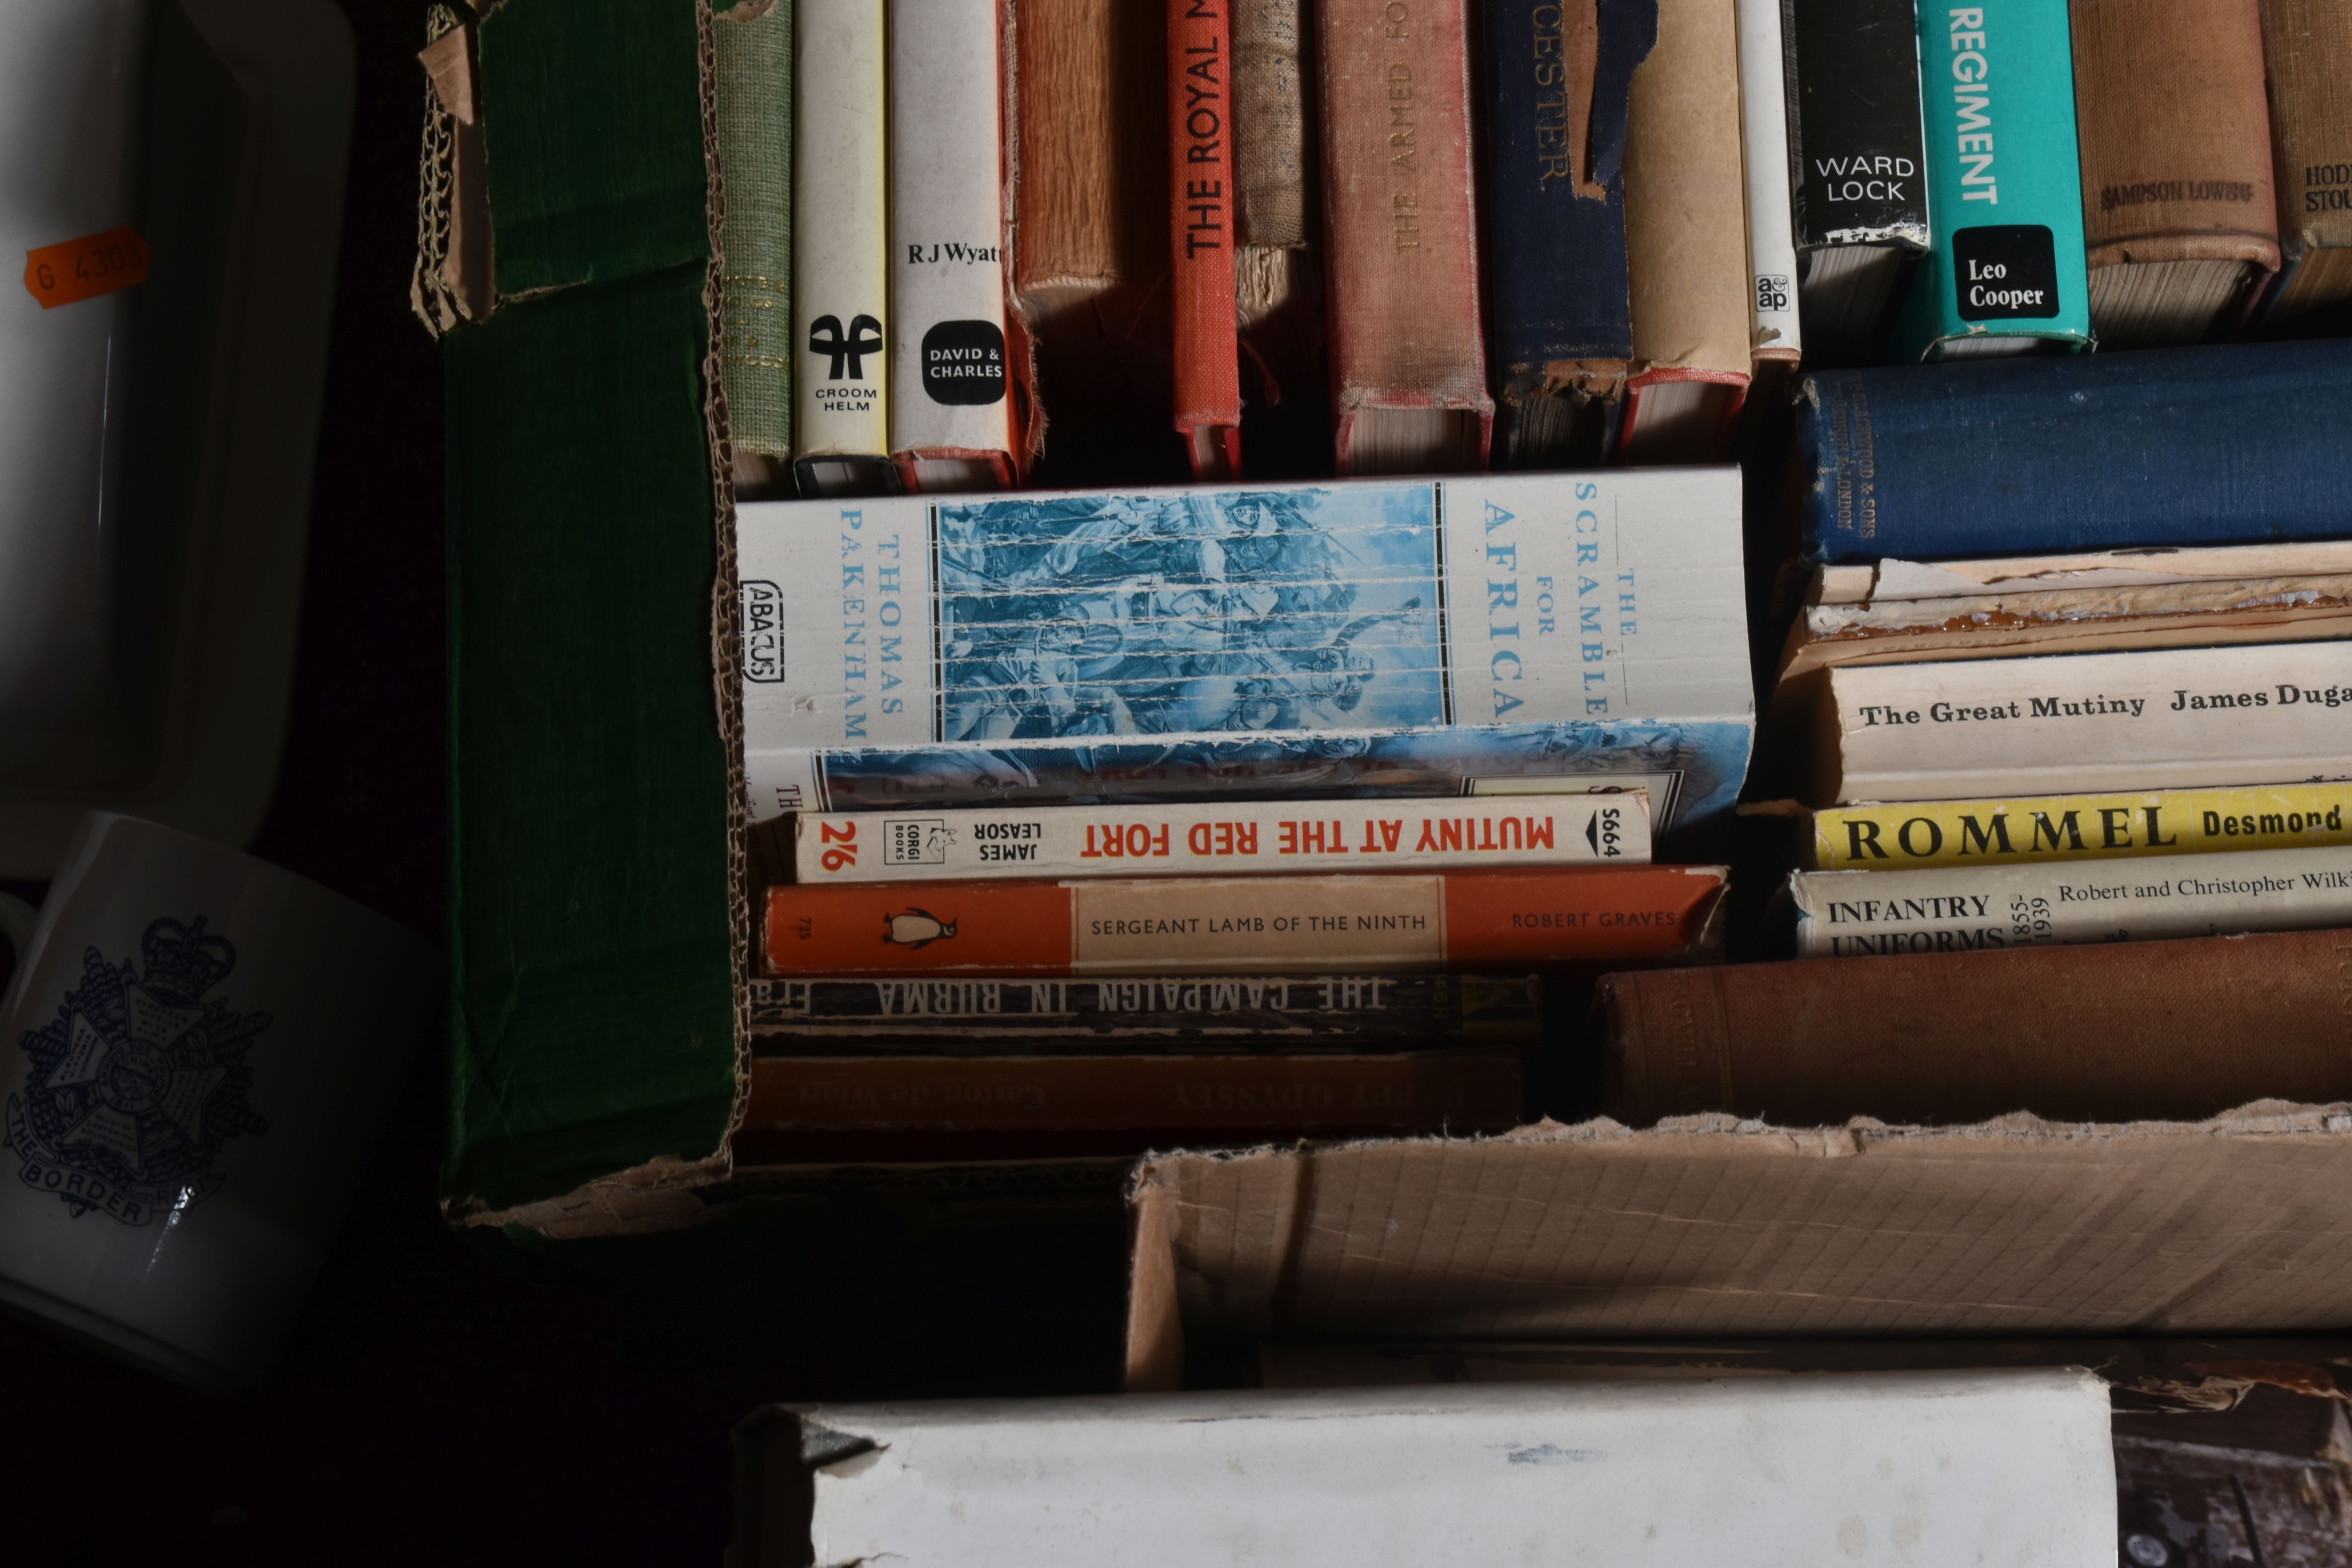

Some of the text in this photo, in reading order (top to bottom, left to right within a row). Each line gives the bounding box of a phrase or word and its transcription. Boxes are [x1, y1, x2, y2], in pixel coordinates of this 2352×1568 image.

[1186, 36, 1220, 164] ROYAL
[1949, 7, 1998, 205] REGIMENT
[1385, 2, 1419, 255] THE ARMED FO
[1816, 156, 1914, 177] WARD
[2305, 163, 2352, 186] HOD
[1828, 181, 1906, 202] LOCK
[1186, 181, 1221, 259] THE
[908, 244, 924, 264] R
[928, 244, 940, 263] J
[1968, 259, 2007, 281] Leo
[1759, 292, 1787, 311] ap
[1969, 285, 2043, 309] Cooper
[930, 348, 1000, 361] DAVID &
[930, 365, 1002, 378] CHARLES
[815, 388, 877, 398] CROOM
[824, 402, 869, 411] HELM
[1837, 470, 1853, 530] LONDON
[1860, 498, 1876, 538] SONS
[1485, 498, 1524, 719] AFRICA
[1536, 575, 1555, 636] FOR
[1575, 482, 1608, 715] SCRAMBLE
[1617, 568, 1637, 636] THE
[749, 586, 775, 676] ABACUS
[841, 508, 867, 739] PAKENHAM
[878, 534, 903, 715] THOMAS
[1859, 684, 2352, 726] The Great Mutiny James Duga
[895, 825, 904, 860] BOOKS
[907, 824, 920, 860] CORGI
[974, 823, 1041, 839] LEASOR
[1080, 816, 1555, 858] MUTINY AT THE RED FORT
[1602, 808, 1621, 858] S664
[1842, 804, 2343, 861] ROMMEL Desmond
[979, 844, 1037, 861] JAMES
[2059, 884, 2128, 902] Robert
[2135, 881, 2171, 898] and
[2177, 875, 2295, 897] Christopher
[1091, 915, 1426, 935] SERGEANT LAMB OF THE NINTH
[1512, 911, 1676, 928] ROBERT GRAVES
[1827, 895, 1990, 923] INFANTRY
[2031, 897, 2053, 939] 1939
[1831, 927, 2005, 956] UNIFORMS
[876, 982, 1001, 1015] BURMA
[1031, 982, 1067, 1014] IN
[1098, 979, 1290, 1012] CAMPAIGN
[1318, 976, 1387, 1010] THE
[129, 1043, 151, 1054] DOS
[122, 1056, 155, 1076] CHINA
[1170, 1083, 1334, 1109] ODYSSEY
[12, 1113, 37, 1157] THE
[24, 1163, 142, 1221] BORDER
